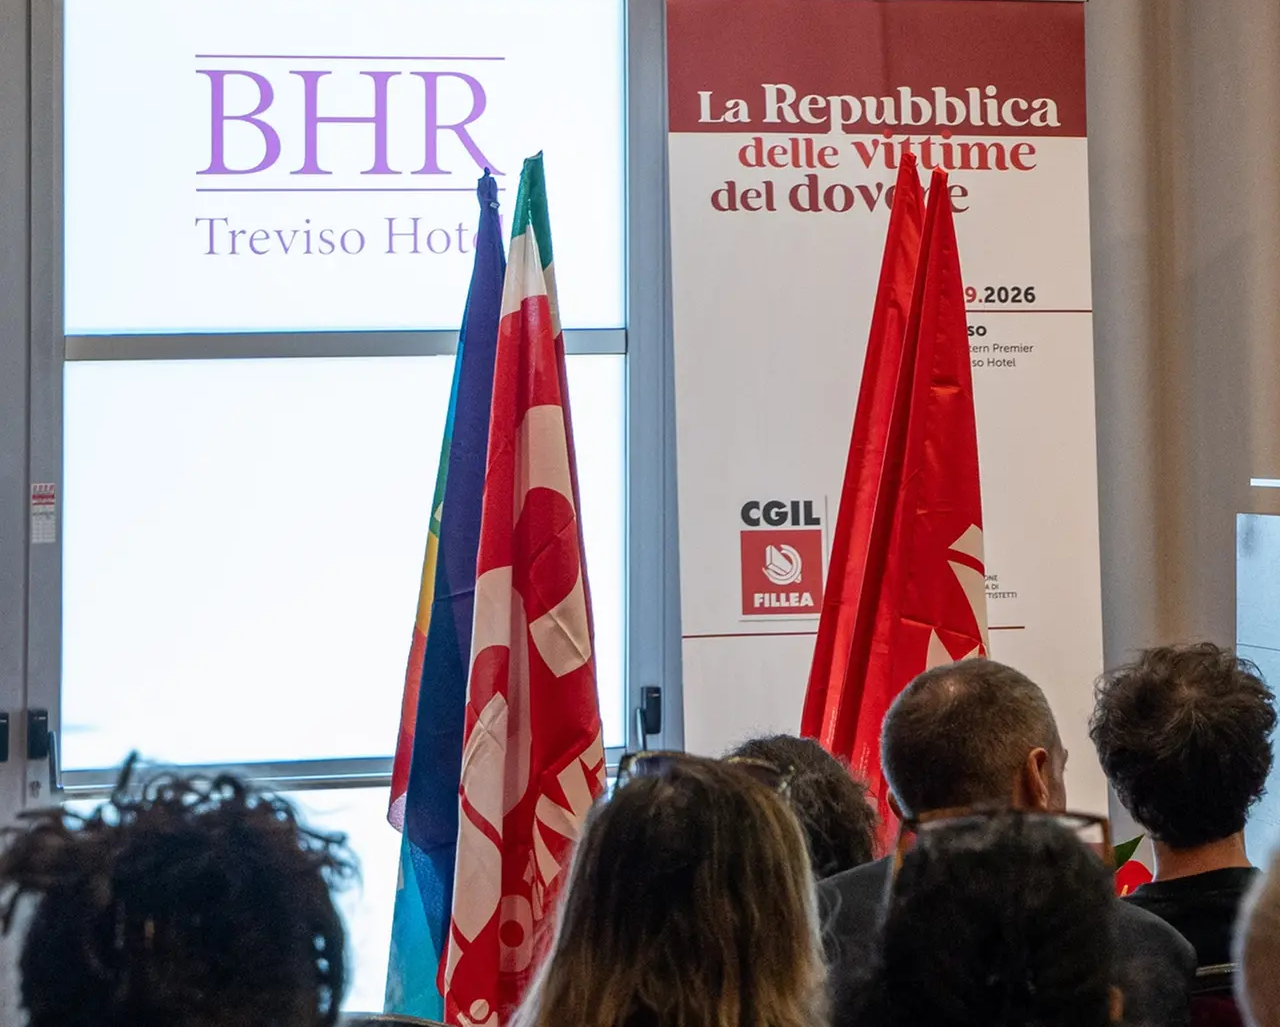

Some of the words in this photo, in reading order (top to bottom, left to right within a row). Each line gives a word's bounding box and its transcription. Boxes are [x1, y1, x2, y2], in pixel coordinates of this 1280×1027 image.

[195, 69, 506, 176] BHR
[697, 91, 751, 123] La
[761, 83, 1061, 134] Repubblica
[738, 136, 840, 170] delle
[711, 180, 776, 212] del
[195, 216, 366, 257] Treviso
[384, 213, 504, 257] Hot
[965, 286, 1036, 304] 9.2026
[987, 358, 1016, 368] Hotel
[992, 343, 1034, 353] Premier
[740, 500, 821, 528] CGIL
[753, 592, 814, 608] FILLEA
